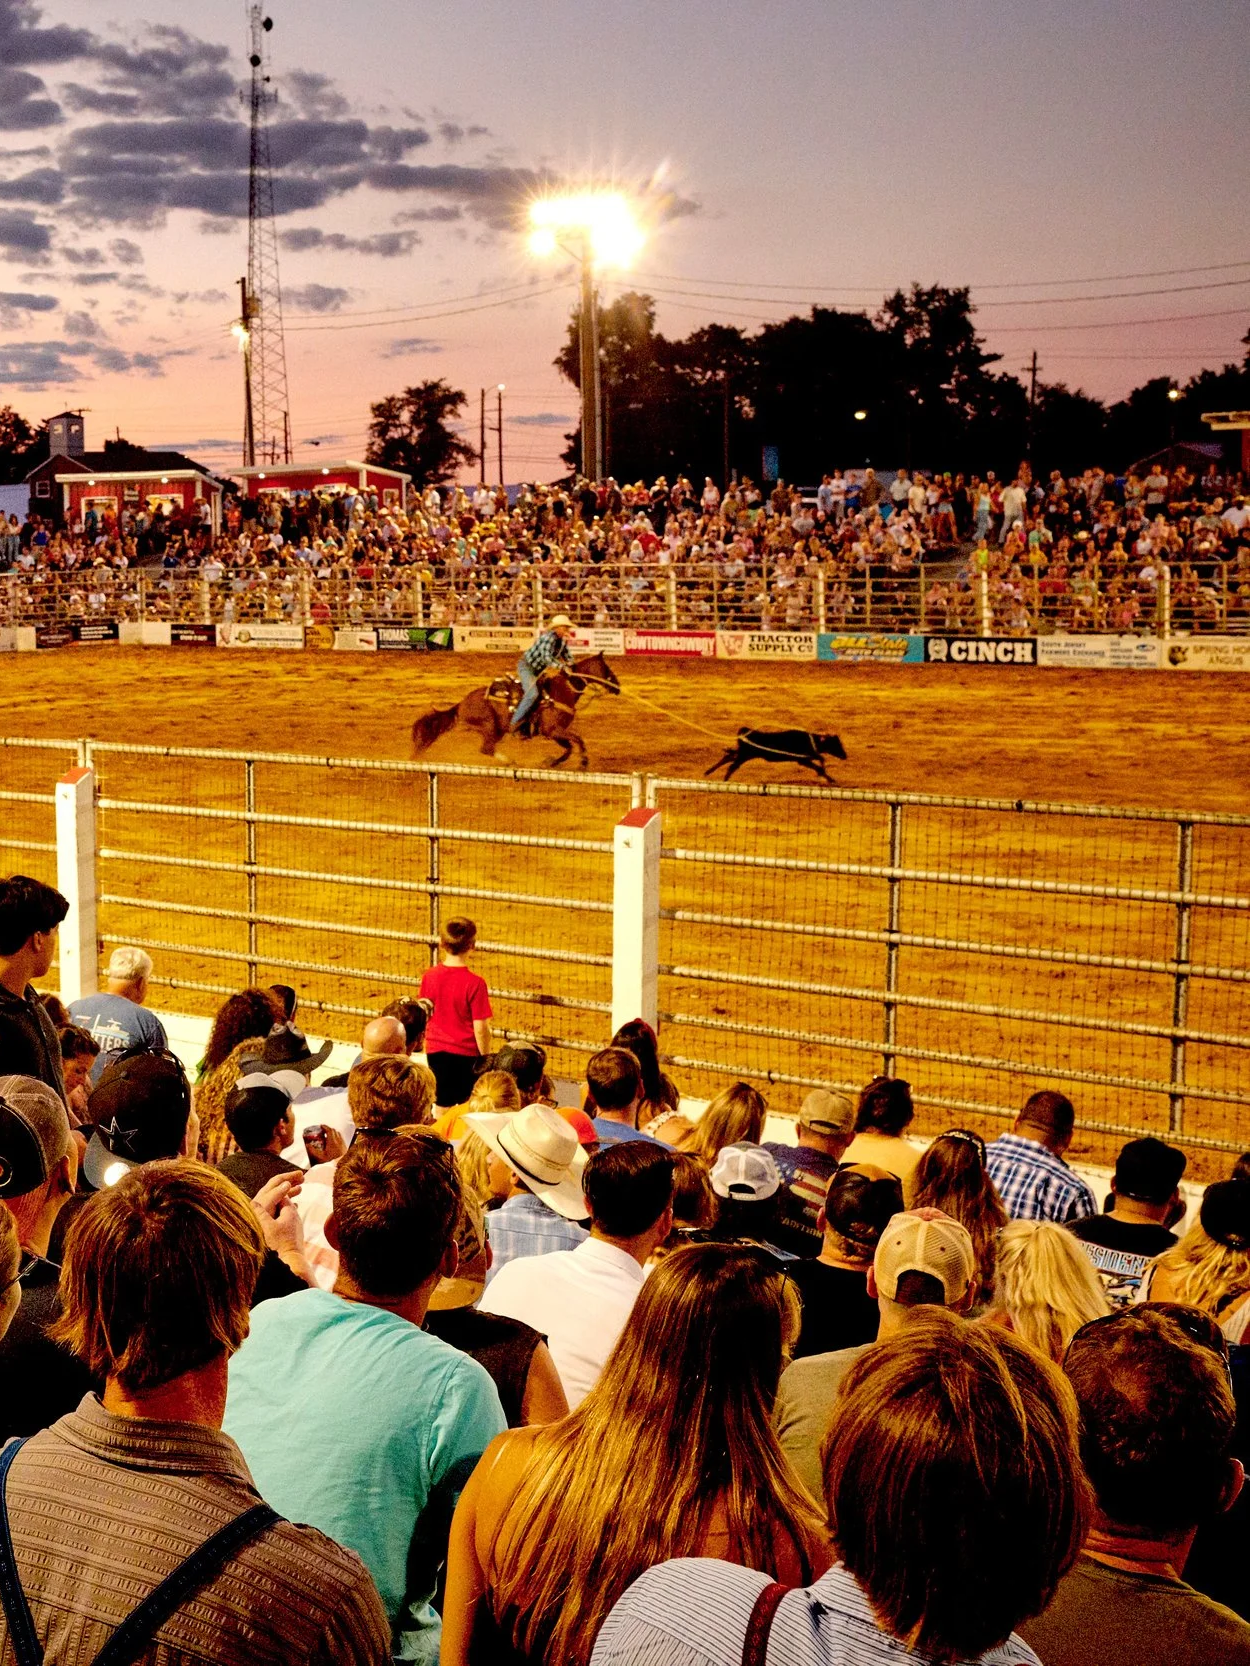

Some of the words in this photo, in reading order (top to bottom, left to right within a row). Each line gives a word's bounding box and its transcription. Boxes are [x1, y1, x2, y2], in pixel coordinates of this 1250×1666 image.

[378, 628, 410, 641] THOMAS
[748, 634, 813, 644] TRACTOR
[748, 643, 794, 653] SUPPLY
[950, 641, 1034, 663] CINCH
[1193, 645, 1229, 654] SPRING
[1208, 655, 1244, 665] ANGUS
